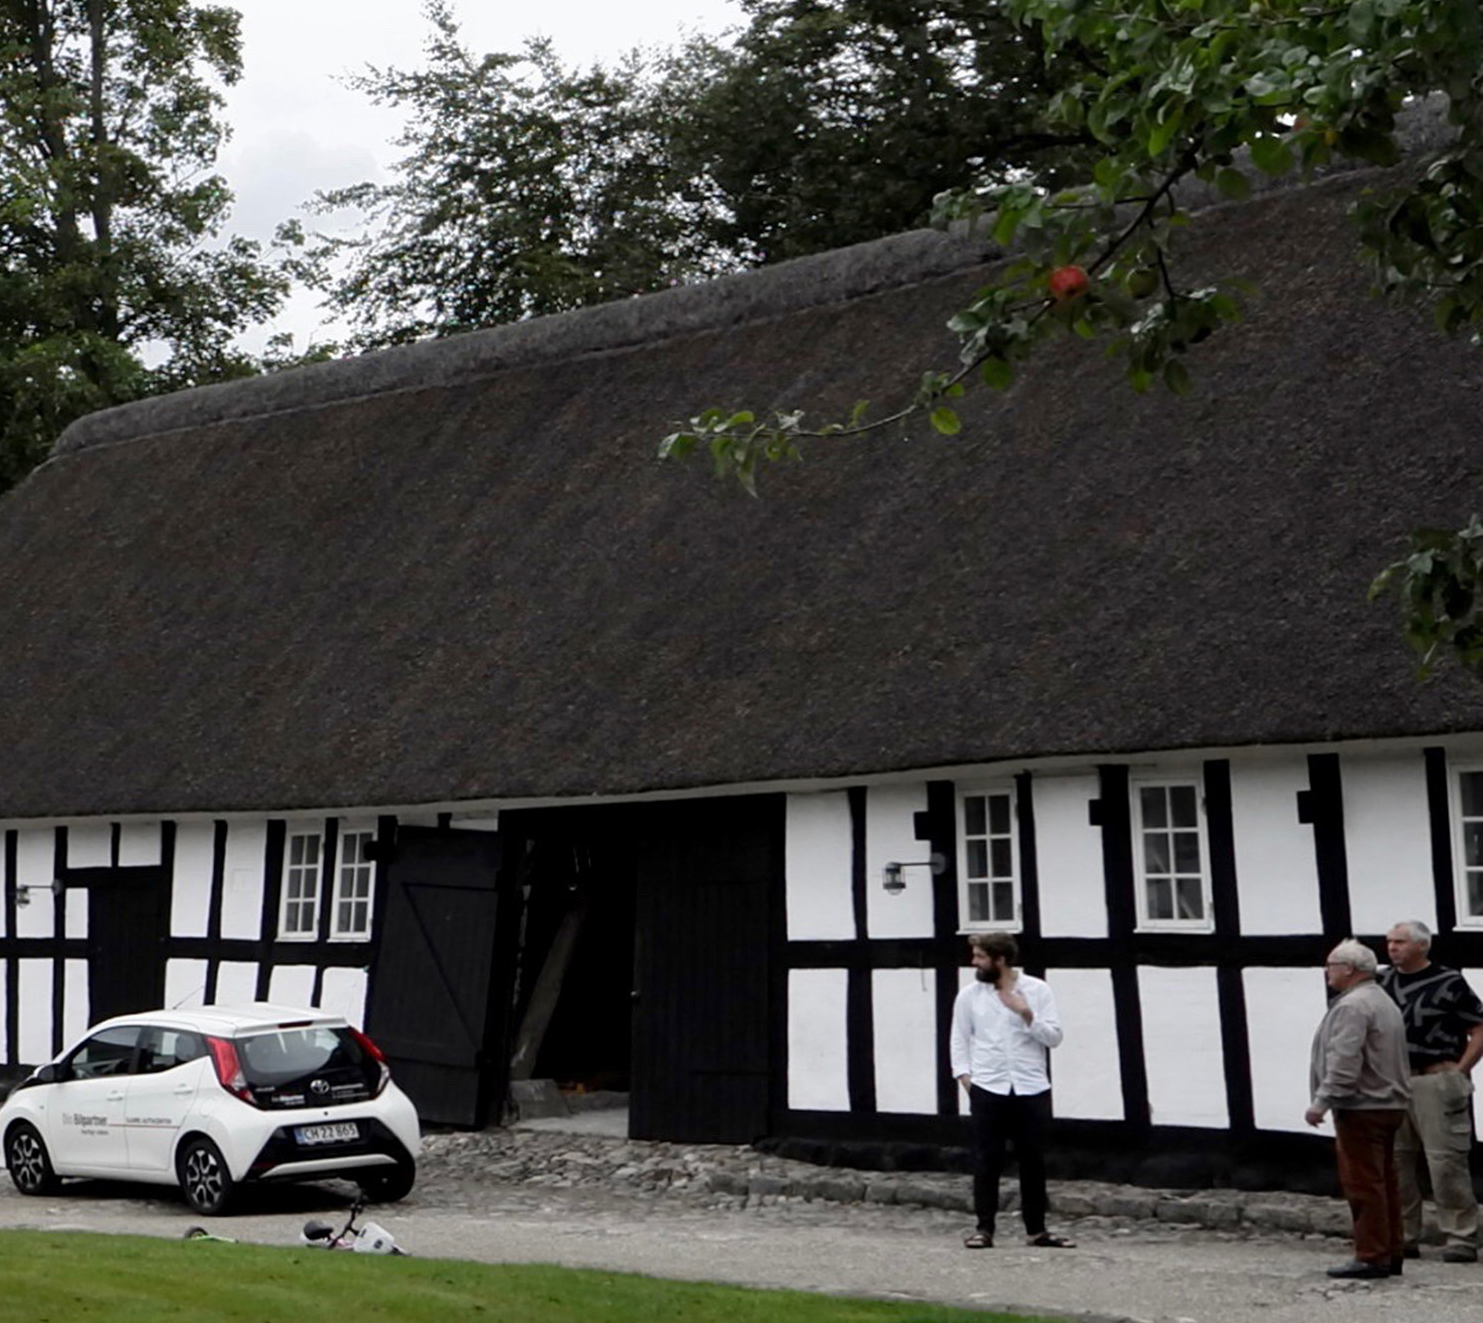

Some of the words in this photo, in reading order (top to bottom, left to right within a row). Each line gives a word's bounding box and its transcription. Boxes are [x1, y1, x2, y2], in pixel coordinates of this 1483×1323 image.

[304, 1128, 319, 1140] CH
[320, 1126, 334, 1138] 22
[335, 1123, 356, 1137] 865
